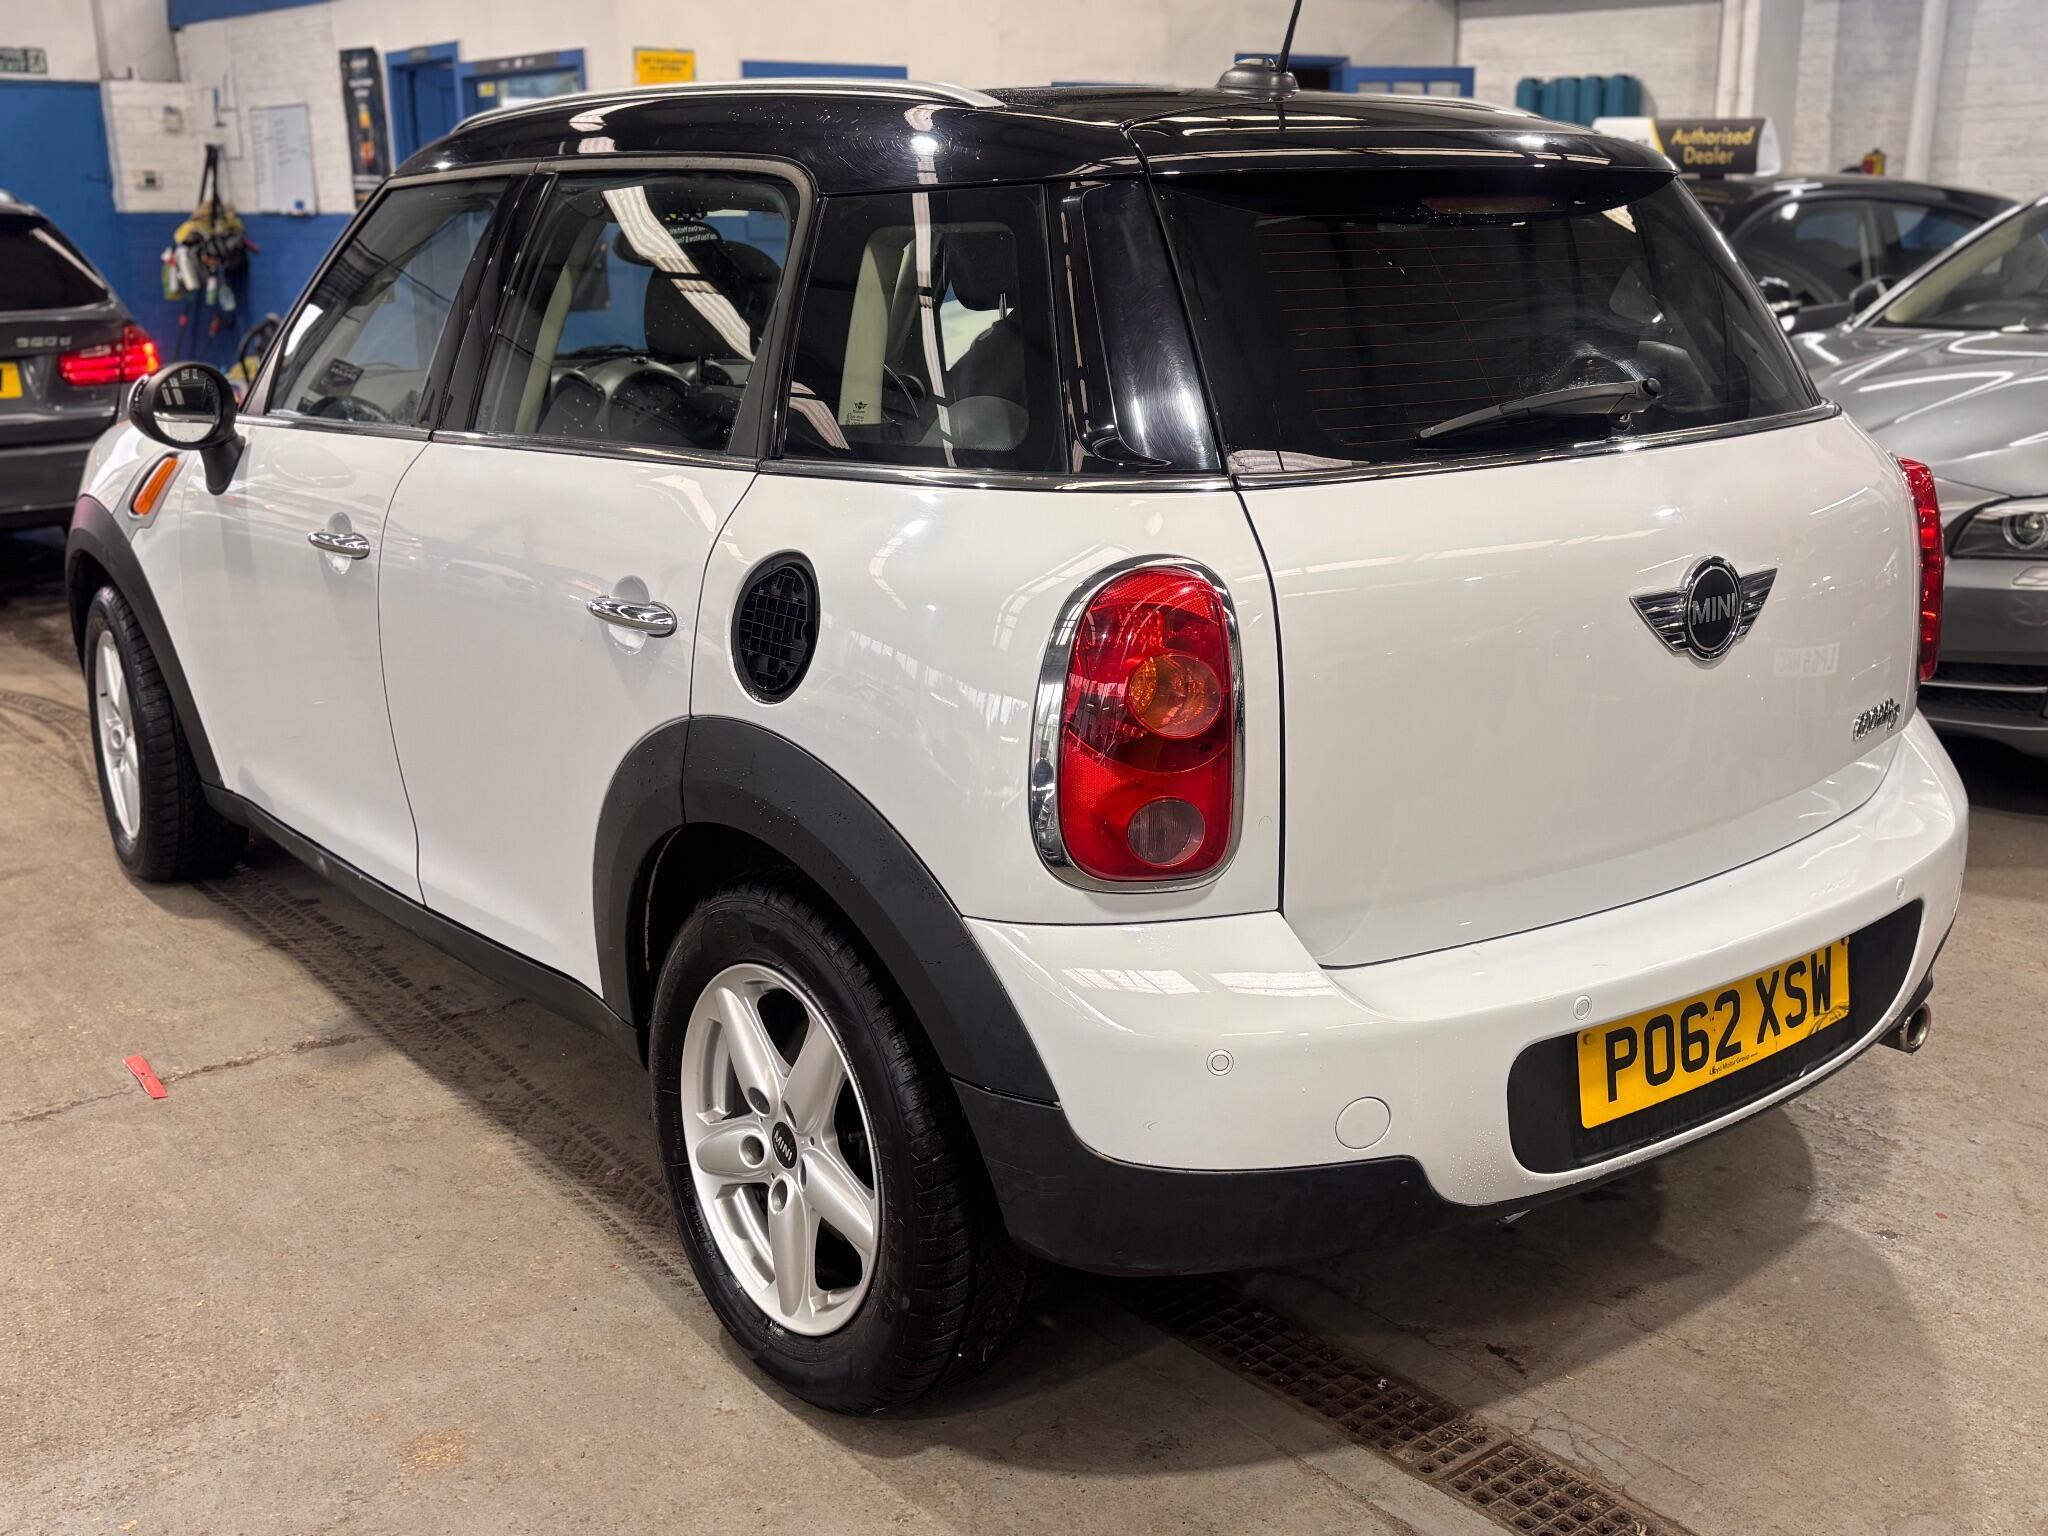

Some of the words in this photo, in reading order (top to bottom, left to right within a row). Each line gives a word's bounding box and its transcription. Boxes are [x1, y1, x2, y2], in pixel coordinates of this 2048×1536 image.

[1672, 127, 1755, 146] Authorised
[1683, 147, 1734, 165] Dealer
[1691, 592, 1736, 626] MINI
[1605, 989, 1742, 1103] PO62
[1756, 946, 1832, 1045] XSW
[1736, 1054, 1750, 1064] Group
[774, 1129, 793, 1161] MINI
